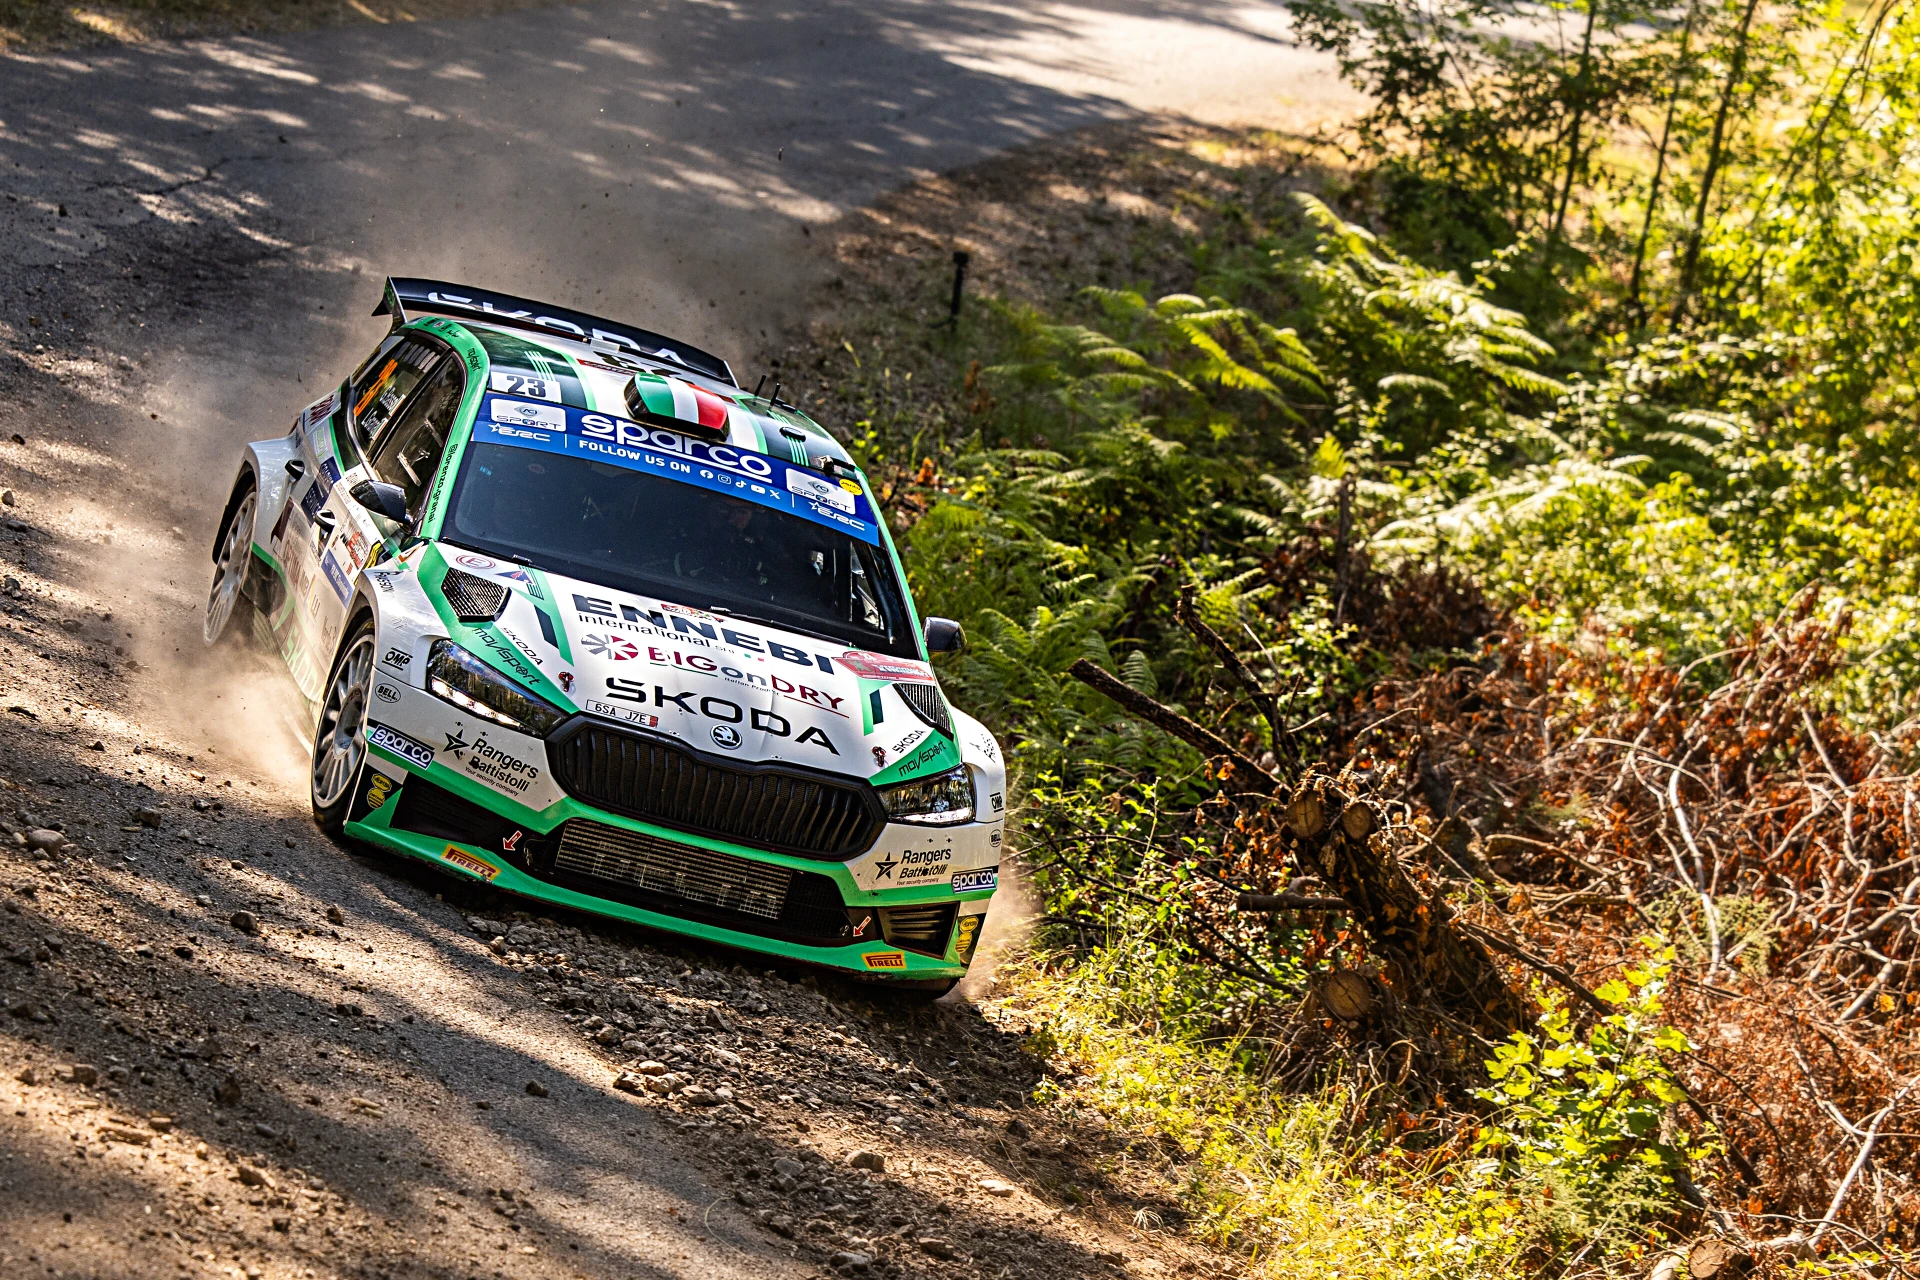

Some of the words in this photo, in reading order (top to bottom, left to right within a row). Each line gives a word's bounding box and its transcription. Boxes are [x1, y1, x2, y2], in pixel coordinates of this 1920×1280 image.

[506, 375, 547, 398] 23
[496, 414, 562, 431] SPORT
[578, 439, 641, 461] FOLLOW
[645, 455, 666, 468] US
[670, 461, 692, 475] ON
[581, 413, 773, 481] sparco
[791, 484, 852, 512] SPORT
[572, 593, 835, 676] ENNEBI
[578, 612, 711, 648] international
[384, 649, 412, 668] OMP
[377, 685, 398, 701] BELL
[594, 702, 617, 717] 6SA
[624, 711, 647, 724] J7E
[605, 676, 841, 757] SKODA
[374, 727, 433, 765] sparco
[891, 729, 927, 754] SKODA
[471, 737, 540, 780] Rangers
[465, 766, 477, 776] Your
[476, 773, 496, 786] security
[495, 782, 519, 797] company
[468, 755, 531, 792] Battistolli
[990, 832, 1002, 843] BELL
[445, 848, 497, 878] PIRELLI
[901, 848, 952, 866] Rangers
[952, 870, 994, 889] sparco
[865, 953, 904, 967] PIRELLI
